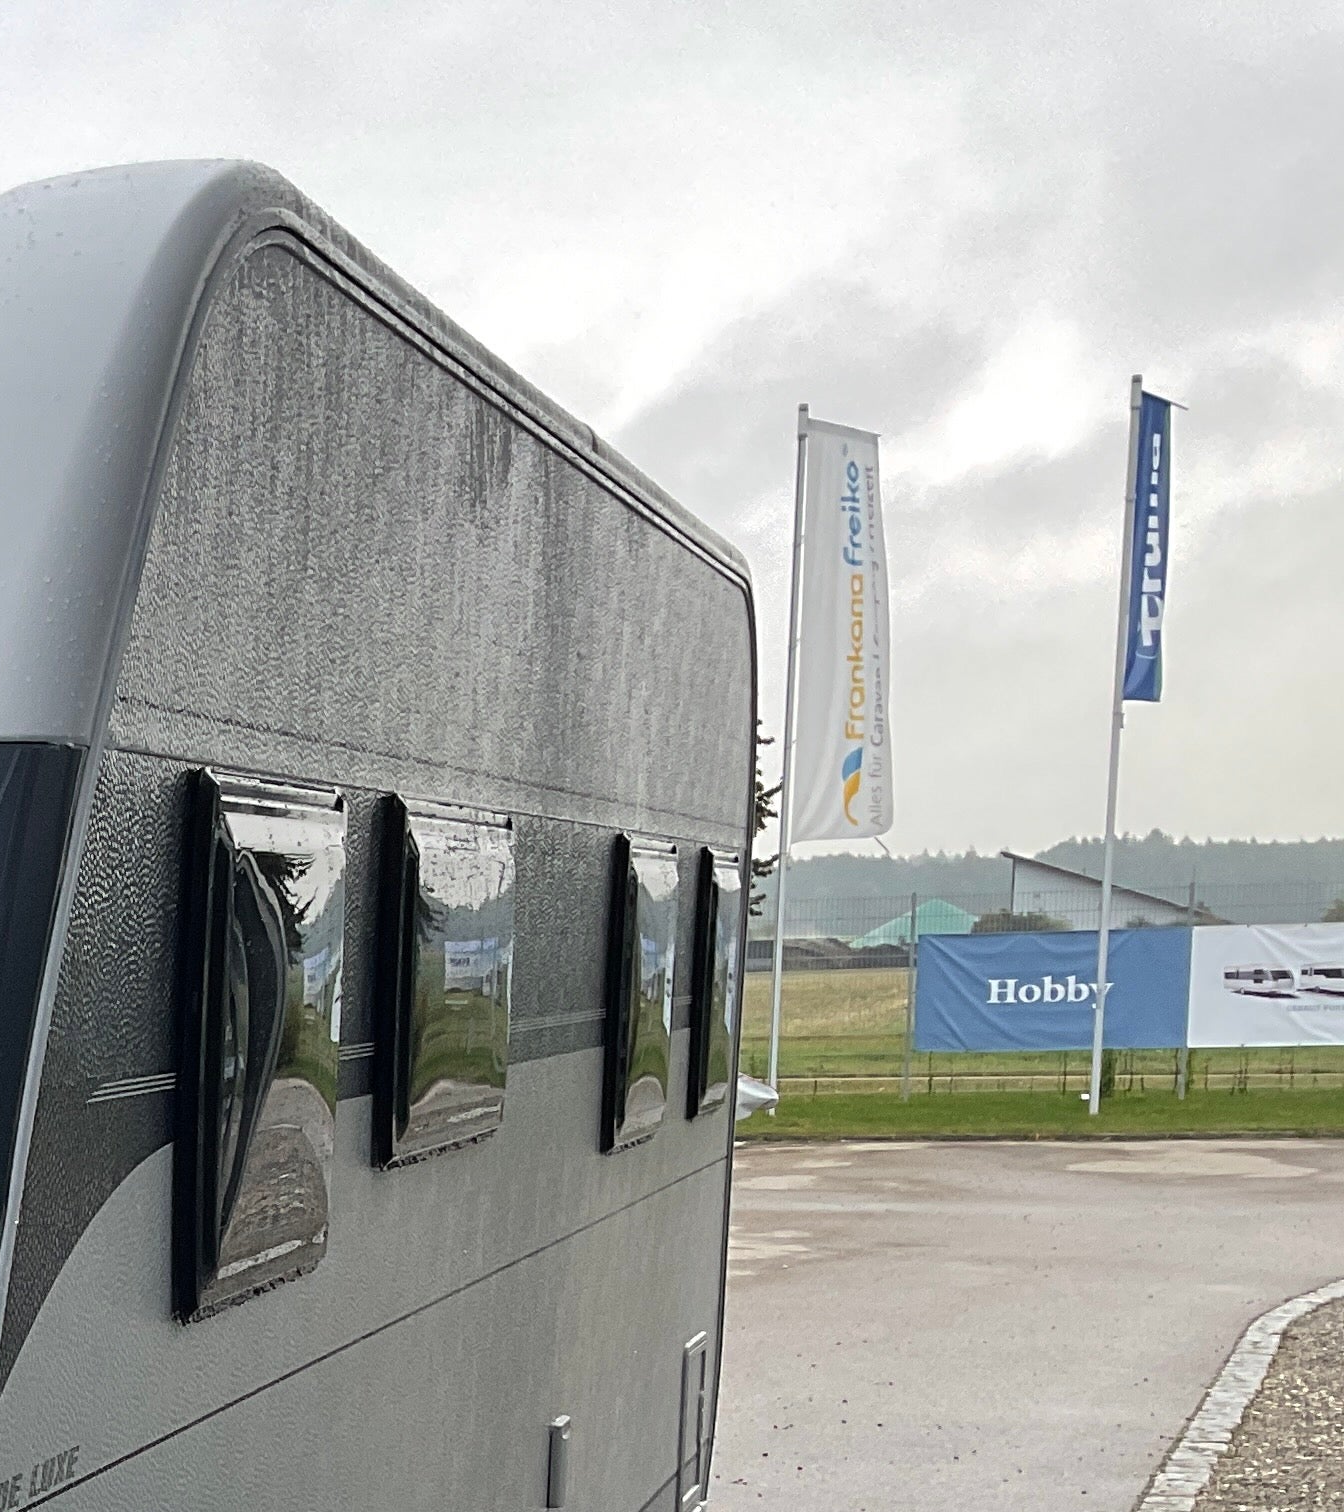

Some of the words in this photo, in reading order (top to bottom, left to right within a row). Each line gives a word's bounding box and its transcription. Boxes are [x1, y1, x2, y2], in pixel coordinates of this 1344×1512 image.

[844, 574, 865, 740] Frankana
[868, 785, 883, 827] Alles
[29, 1445, 80, 1497] LUXE
